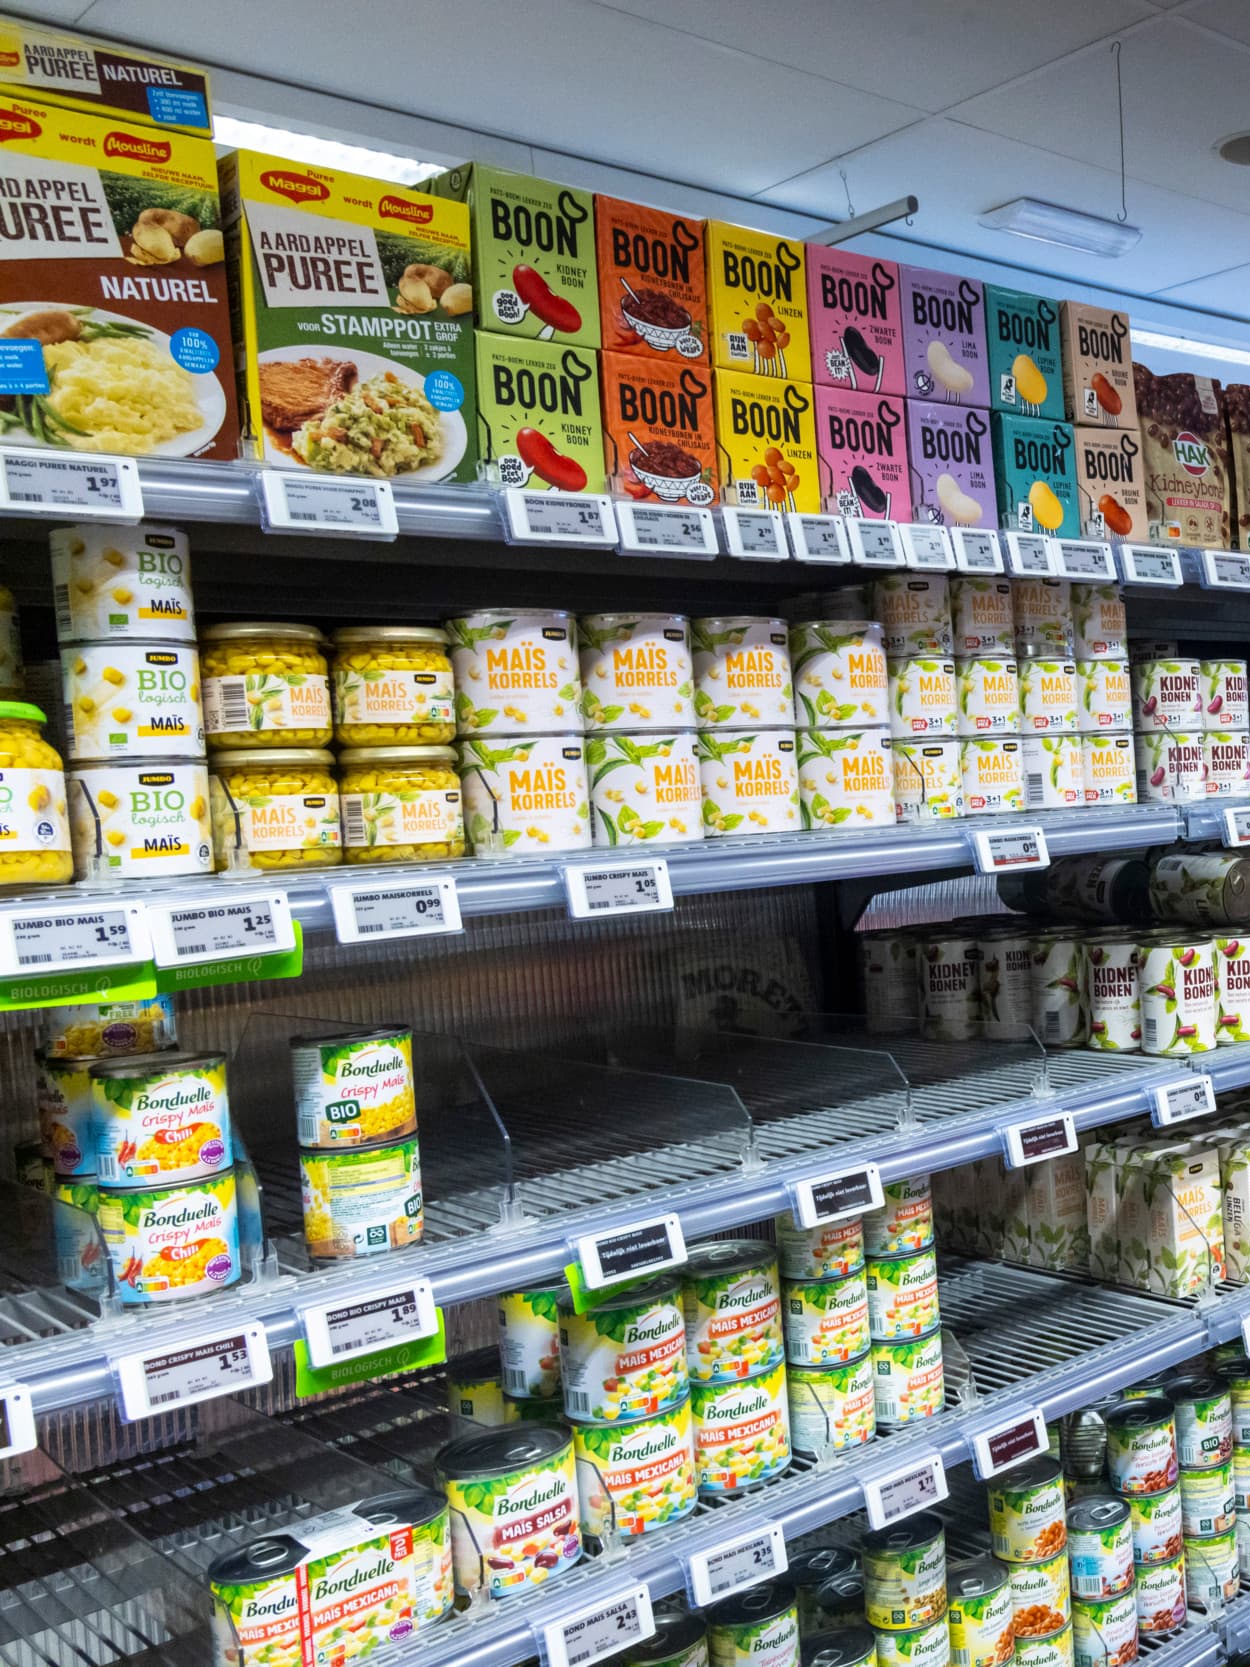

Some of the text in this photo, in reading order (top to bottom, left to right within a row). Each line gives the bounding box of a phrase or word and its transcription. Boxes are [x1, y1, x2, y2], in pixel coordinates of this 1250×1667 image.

[26, 55, 98, 82] PUREE
[101, 64, 183, 86] NATUREL
[59, 131, 96, 147] wordt
[343, 195, 373, 209] wordt
[490, 197, 579, 259] BOON
[260, 231, 371, 259] AARDAPPEL
[612, 227, 690, 284] BOON
[263, 253, 380, 295] PUREE
[556, 264, 588, 280] KIDNEY
[561, 276, 584, 289] BOON
[723, 249, 792, 303] BOON
[100, 275, 218, 304] NATUREL
[821, 273, 888, 321] BOON
[912, 290, 973, 335] BOON
[297, 313, 432, 340] VOOR STAMPPOT
[434, 322, 462, 334] EXTRA
[436, 332, 458, 342] GROF
[997, 309, 1050, 352] BOON
[1078, 325, 1123, 364] BOON
[492, 364, 583, 417] BOON
[619, 382, 699, 432] BOON
[561, 423, 592, 436] KIDNEY
[731, 398, 801, 445] BOON
[566, 435, 590, 447] BOON
[829, 415, 894, 457] BOON
[921, 425, 981, 465] BOON
[786, 449, 813, 460] LINZEN
[1015, 437, 1066, 476] BOON
[1174, 441, 1210, 466] HAK
[38, 461, 68, 472] PUREE
[69, 464, 109, 475] NATUREL
[876, 462, 903, 474] ZWARTE
[970, 471, 984, 480] LIMA
[1084, 449, 1134, 482] BOON
[969, 478, 987, 489] BOON
[136, 552, 184, 576] BIO
[149, 654, 176, 663] JUMBO
[486, 641, 547, 673] MAÏS
[612, 641, 668, 671] MAÏS
[725, 645, 774, 673] MAÏS
[136, 669, 187, 692] BIO
[488, 671, 558, 690] KORRELS
[614, 670, 677, 688] KORRELS
[727, 672, 782, 690] KORRELS
[365, 681, 408, 700] MAÏS
[1161, 691, 1192, 703] BONEN
[366, 699, 415, 712] KORRELS
[150, 713, 184, 731] MAÏS
[733, 753, 782, 782] MAÏS
[842, 749, 885, 778] MAÏS
[977, 751, 1013, 772] MAÏS
[1168, 760, 1199, 773] BONEN
[1212, 759, 1242, 771] BONEN
[141, 774, 173, 784] JUMBO
[509, 761, 566, 793] MAÏS
[844, 775, 890, 793] KORRELS
[735, 779, 790, 798] KORRELS
[129, 789, 185, 813] BIO
[401, 799, 440, 820] MAÏS
[511, 792, 577, 812] KORRELS
[131, 812, 187, 829] logisch
[251, 804, 296, 826] MAÏS
[144, 836, 182, 853] MAÏS
[584, 873, 608, 883] JUMBO
[13, 914, 105, 931] JUMBO BIO MAIS
[171, 905, 252, 923] JUMBO BIO MAIS
[176, 961, 242, 981] BIOLOGISCH
[11, 982, 89, 1001] BIOLOGISCH
[929, 978, 967, 993] BONEN
[1094, 983, 1132, 998] BONEN
[340, 1055, 404, 1079] Bonduelle
[136, 1085, 212, 1112] Bonduelle
[341, 1082, 379, 1102] Crispy
[142, 1110, 185, 1132] Crispy
[330, 1102, 358, 1121] BIO
[165, 1128, 193, 1144] Chili
[143, 1201, 219, 1229] Bonduelle
[148, 1227, 191, 1248] Crispy
[170, 1244, 199, 1261] Chili
[719, 1282, 774, 1311] Bonduelle
[327, 1310, 349, 1323] BOND
[349, 1307, 363, 1317] BIO
[363, 1300, 388, 1314] CRISPY
[168, 1352, 195, 1367] CRISPY
[196, 1347, 215, 1360] MAIS
[215, 1340, 234, 1353] CHILI
[331, 1355, 393, 1380] BIOLOGISCH
[707, 1394, 768, 1421] Bonduelle
[727, 1415, 776, 1439] MEXICANA
[611, 1432, 677, 1463] Bonduelle
[1203, 1438, 1219, 1450] BIO
[634, 1453, 685, 1481] MEXICANA
[497, 1479, 566, 1517] Bonduelle
[536, 1504, 568, 1529] SALSA
[394, 1539, 406, 1552] 2
[314, 1557, 395, 1601] Bonduelle
[343, 1582, 400, 1615] MEXICANA
[564, 1603, 628, 1636] BOND MAIS SALSA
